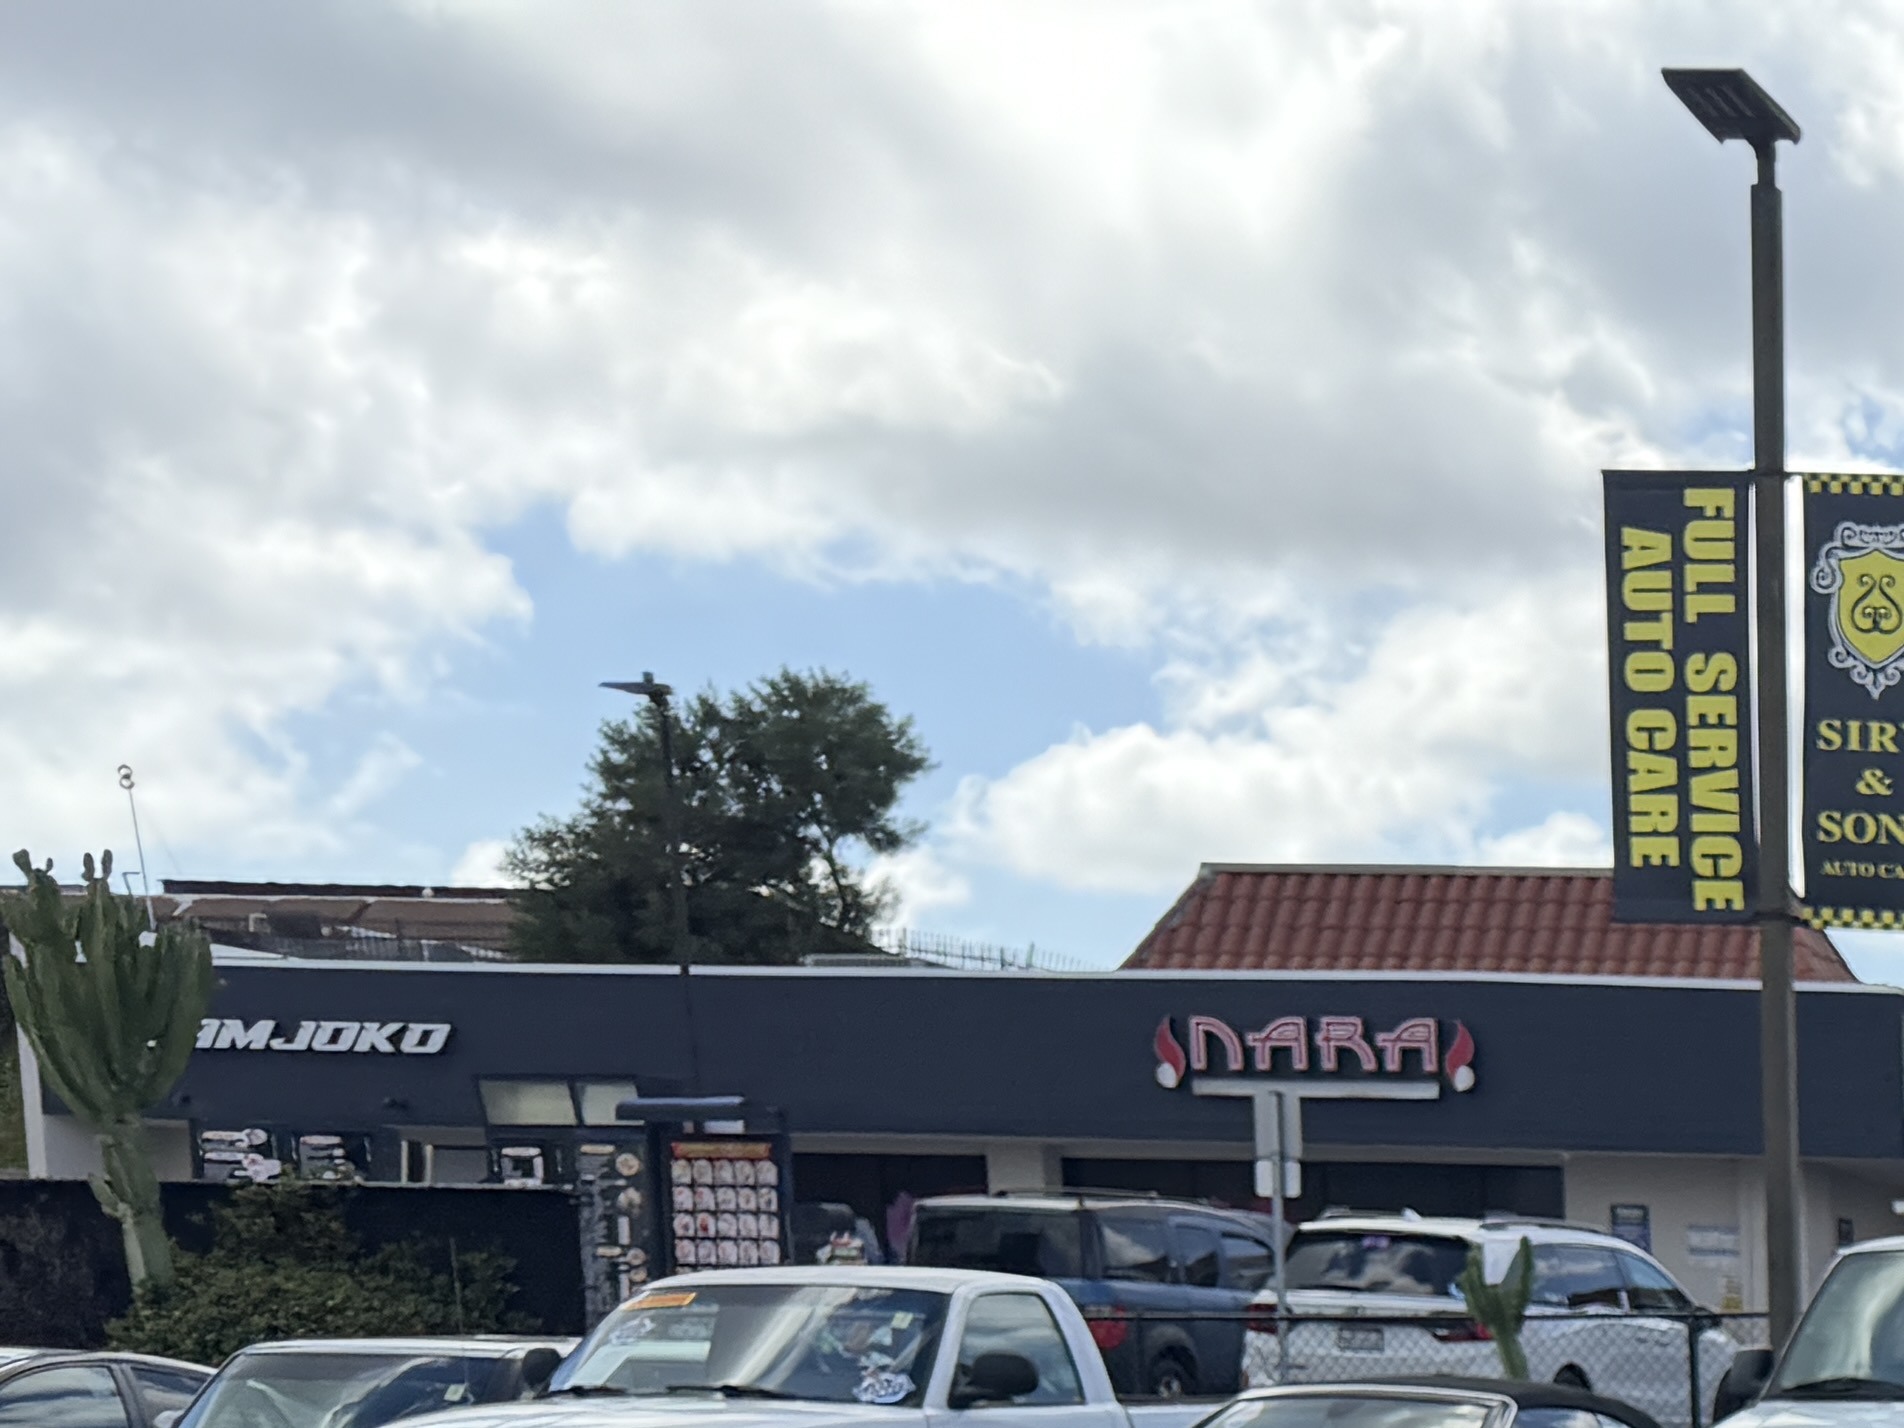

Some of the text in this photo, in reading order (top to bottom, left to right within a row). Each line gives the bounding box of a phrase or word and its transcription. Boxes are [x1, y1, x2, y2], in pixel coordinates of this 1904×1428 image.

[1620, 526, 1680, 869] AUTO CARE
[1683, 488, 1745, 912] FULL SERVICE
[1855, 768, 1893, 796] &
[1821, 860, 1875, 877] AUTO
[1188, 1014, 1439, 1073] NARA
